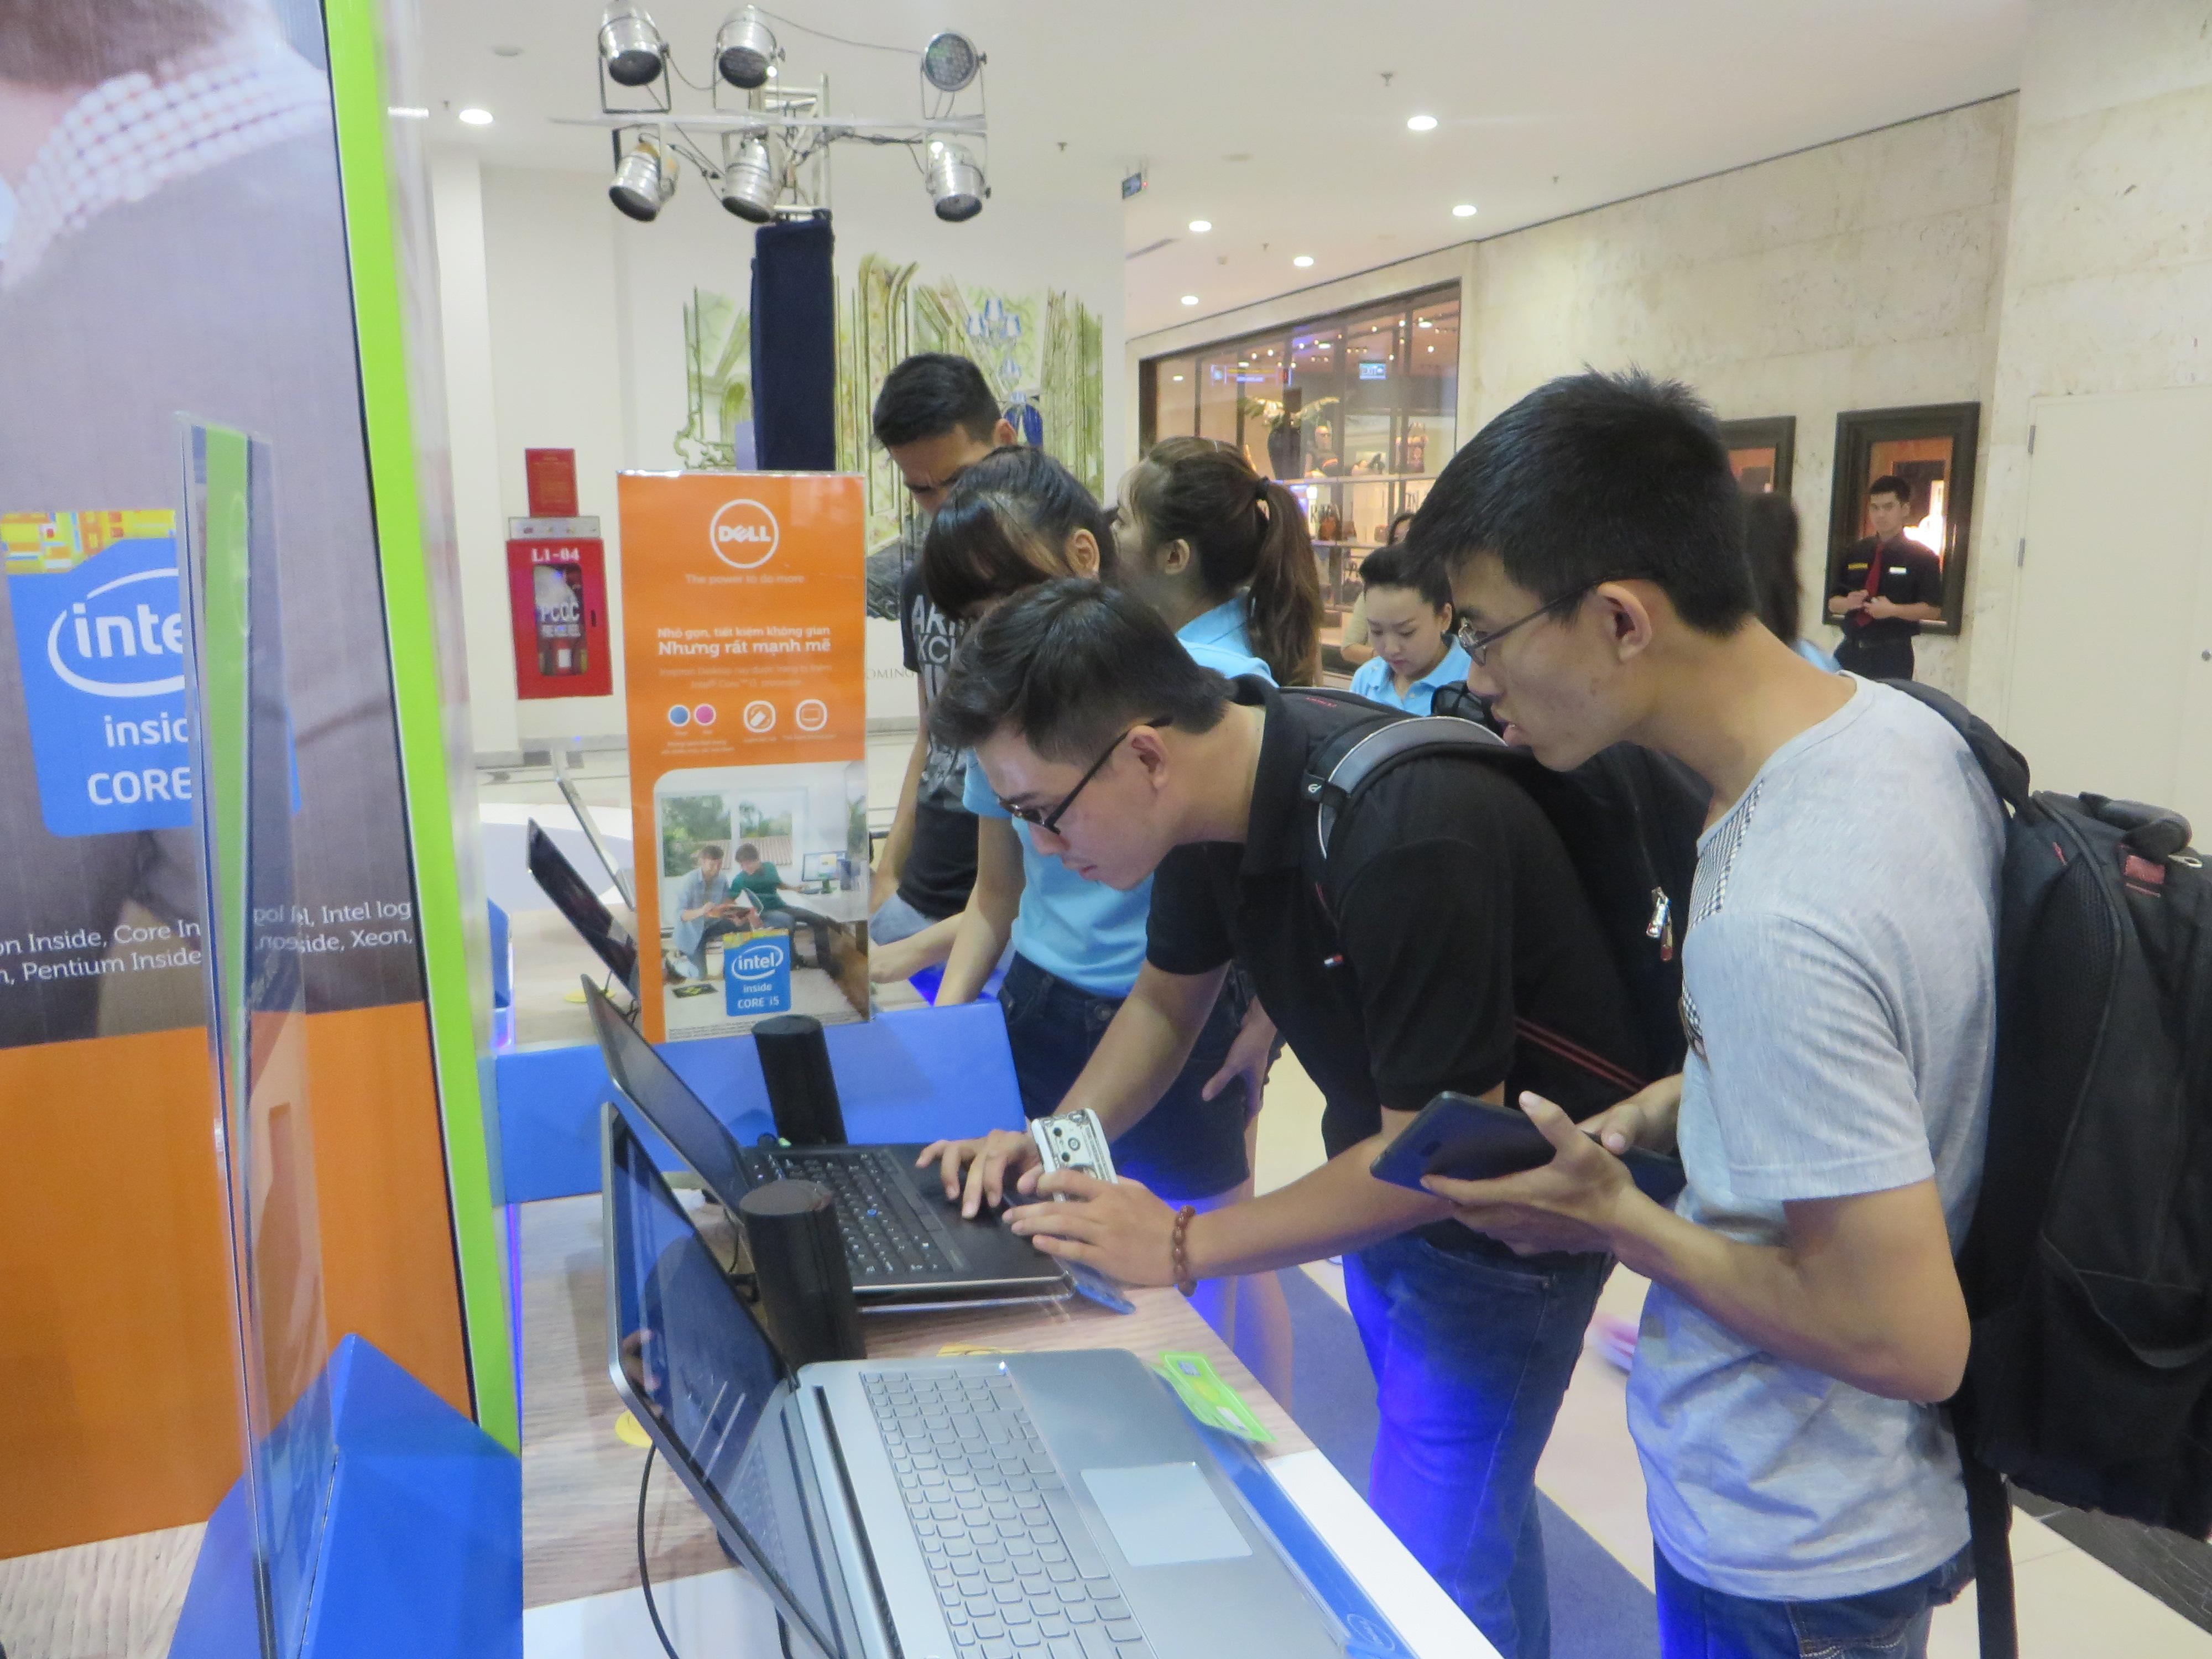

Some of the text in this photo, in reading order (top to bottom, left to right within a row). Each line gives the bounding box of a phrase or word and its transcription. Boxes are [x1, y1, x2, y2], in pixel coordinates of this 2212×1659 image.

[719, 525, 771, 542] DELL
[87, 766, 192, 805] CORE
[322, 901, 372, 924] Intel
[28, 928, 107, 953] Inside,
[114, 924, 171, 944] Core
[349, 929, 413, 948] Xeon,
[22, 957, 124, 981] Pentium
[131, 948, 202, 971] Inside
[738, 952, 774, 970] intel
[743, 983, 772, 993] inside
[737, 997, 764, 1009] CORE
